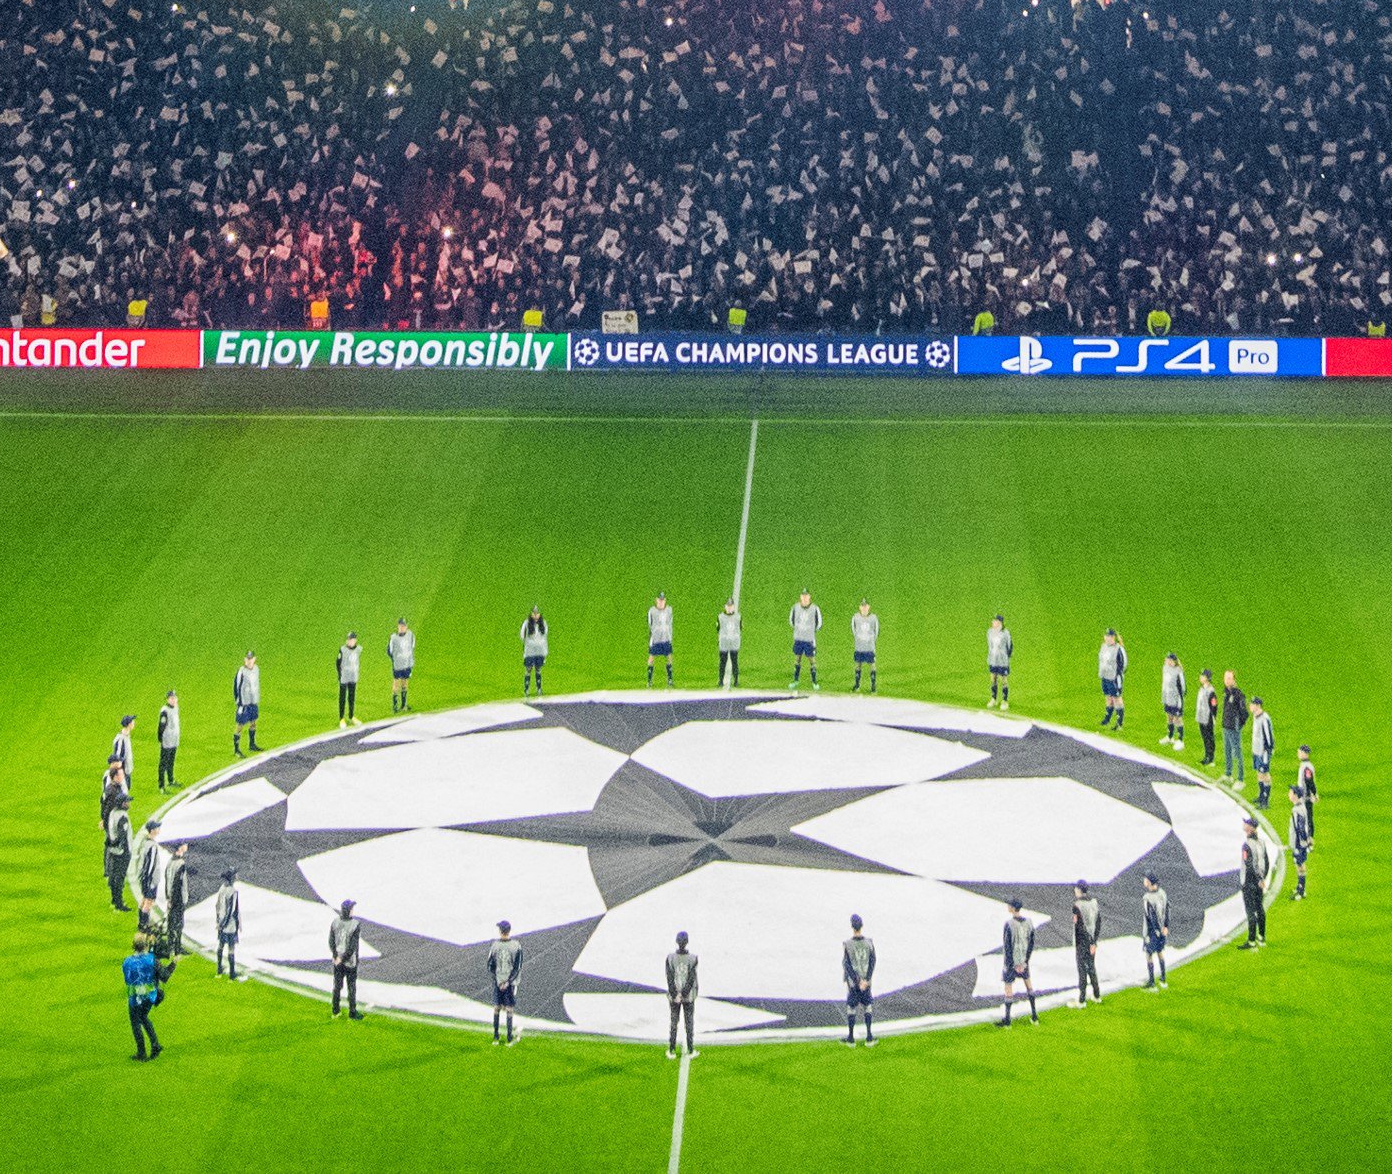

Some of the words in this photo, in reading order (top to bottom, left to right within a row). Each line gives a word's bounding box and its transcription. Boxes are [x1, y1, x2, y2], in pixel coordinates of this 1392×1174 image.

[215, 330, 320, 369] Enjoy
[329, 331, 555, 371] Responsibly
[606, 342, 669, 363] UEFA
[675, 342, 818, 364] CHAMPIONS
[827, 343, 918, 364] LEAGUE
[1072, 339, 1216, 373] PS4
[1237, 348, 1270, 365] Pro
